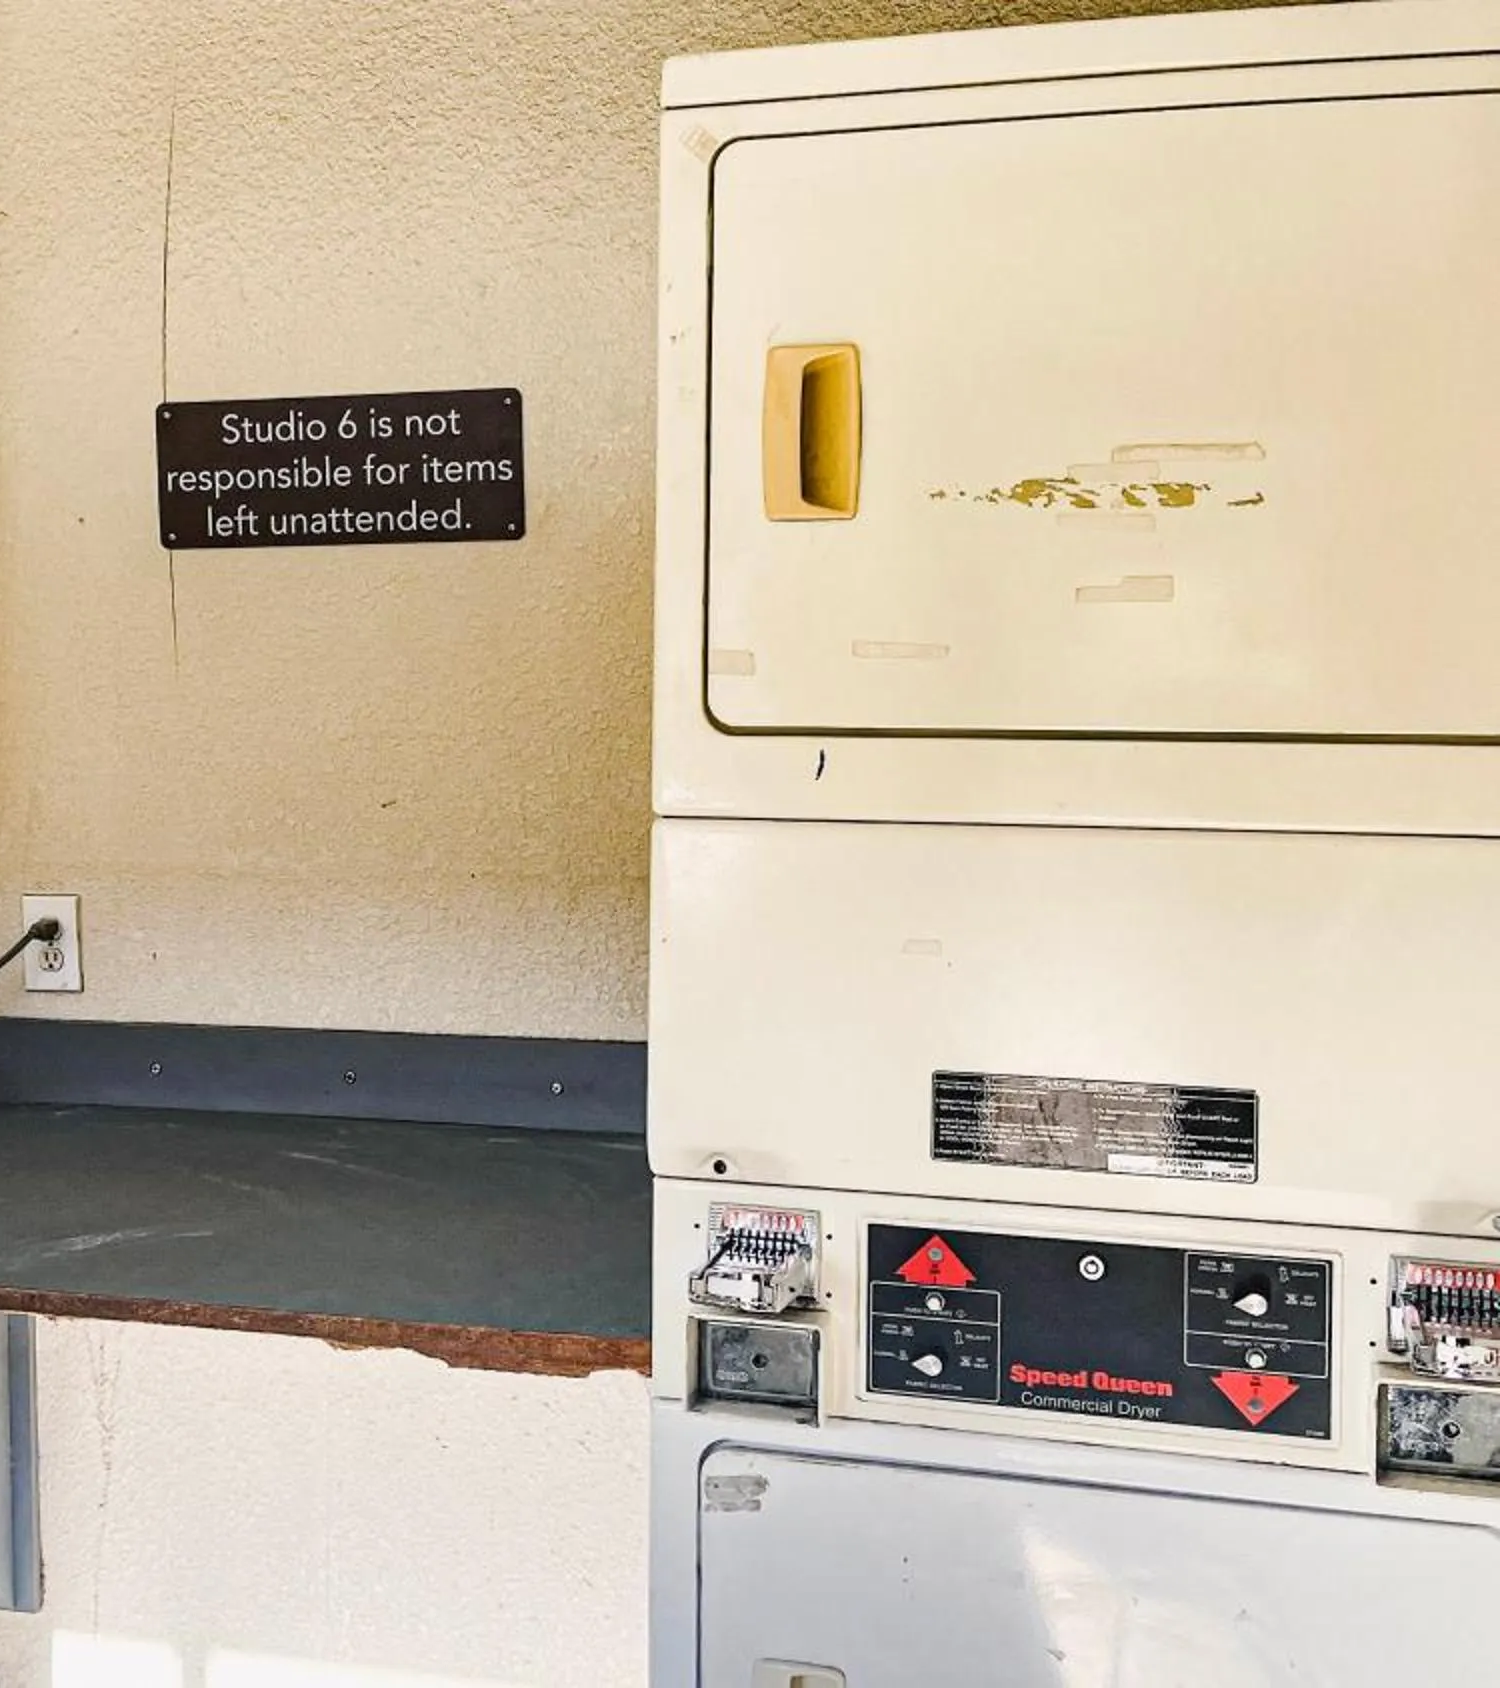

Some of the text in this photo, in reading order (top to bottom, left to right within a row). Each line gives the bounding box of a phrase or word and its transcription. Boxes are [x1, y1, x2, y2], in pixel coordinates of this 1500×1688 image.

[221, 408, 462, 446] Studio 6 is not
[166, 453, 513, 499] responsible for items
[207, 498, 472, 537] left unattended.
[1009, 1362, 1088, 1387] Speed
[1092, 1371, 1174, 1397] Queen
[1021, 1391, 1162, 1419] Commercial Dryer
